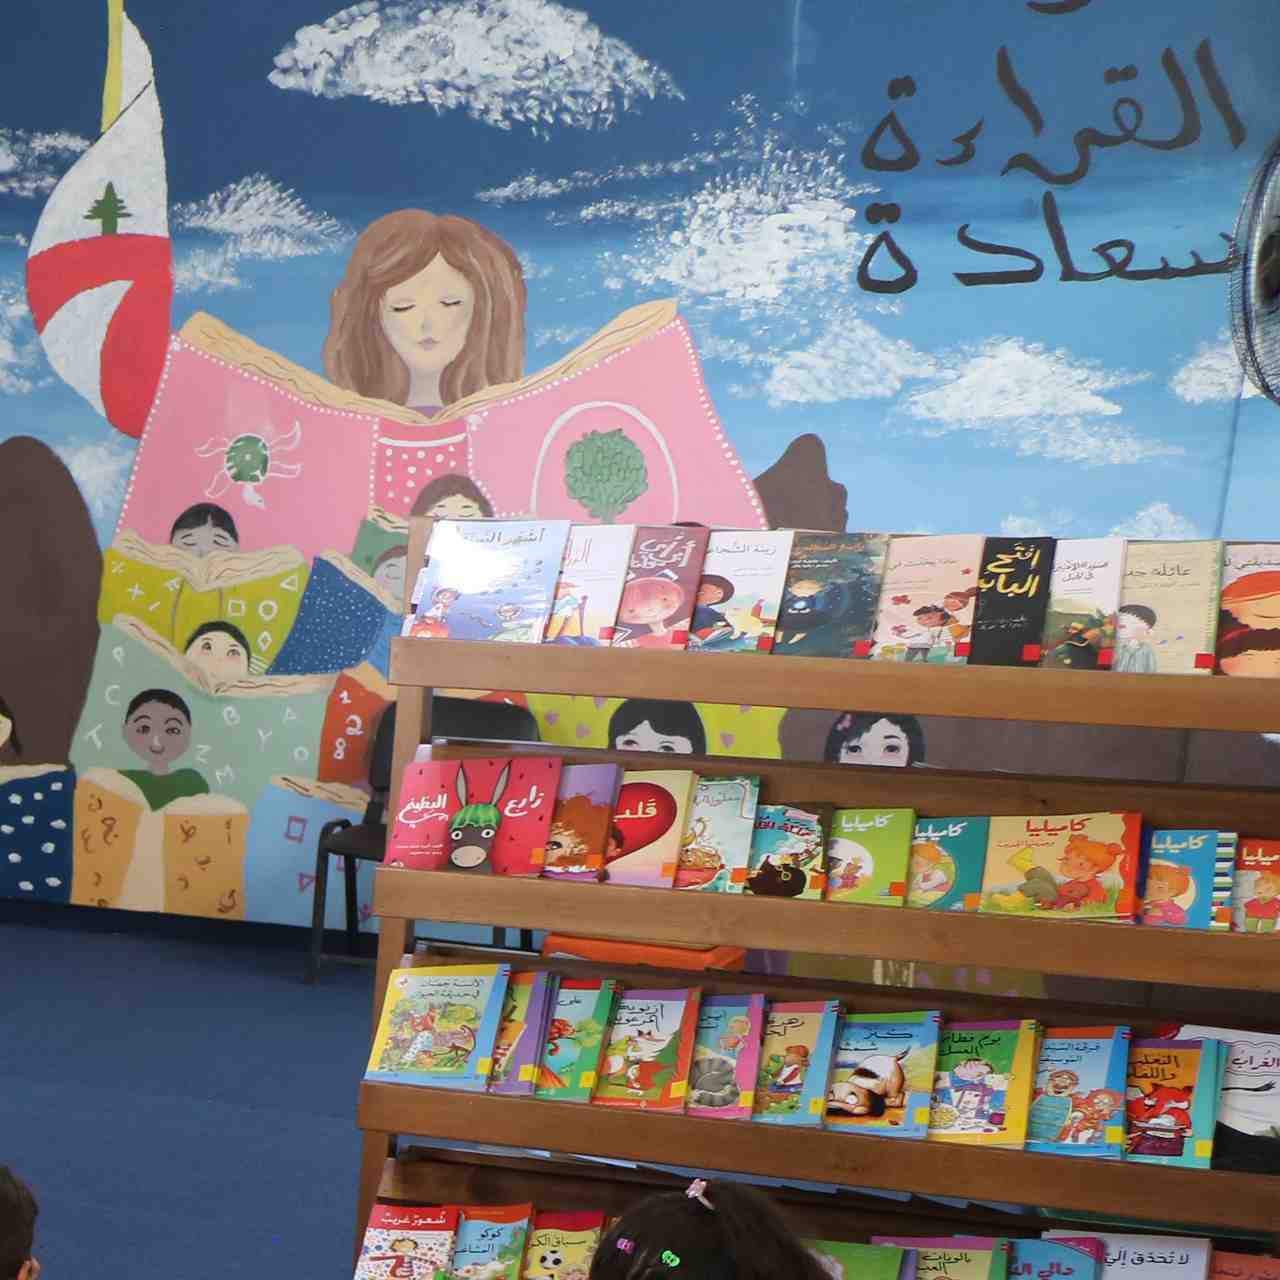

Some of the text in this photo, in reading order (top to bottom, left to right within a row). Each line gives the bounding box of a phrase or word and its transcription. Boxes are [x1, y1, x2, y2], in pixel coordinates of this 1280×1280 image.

[859, 38, 1248, 185] القراءة
[345, 715, 364, 736] 2
[841, 814, 893, 832] كاميليا
[914, 822, 967, 841] كاميليا
[1025, 817, 1091, 836] كاميليا
[1151, 834, 1209, 853] كاميليا
